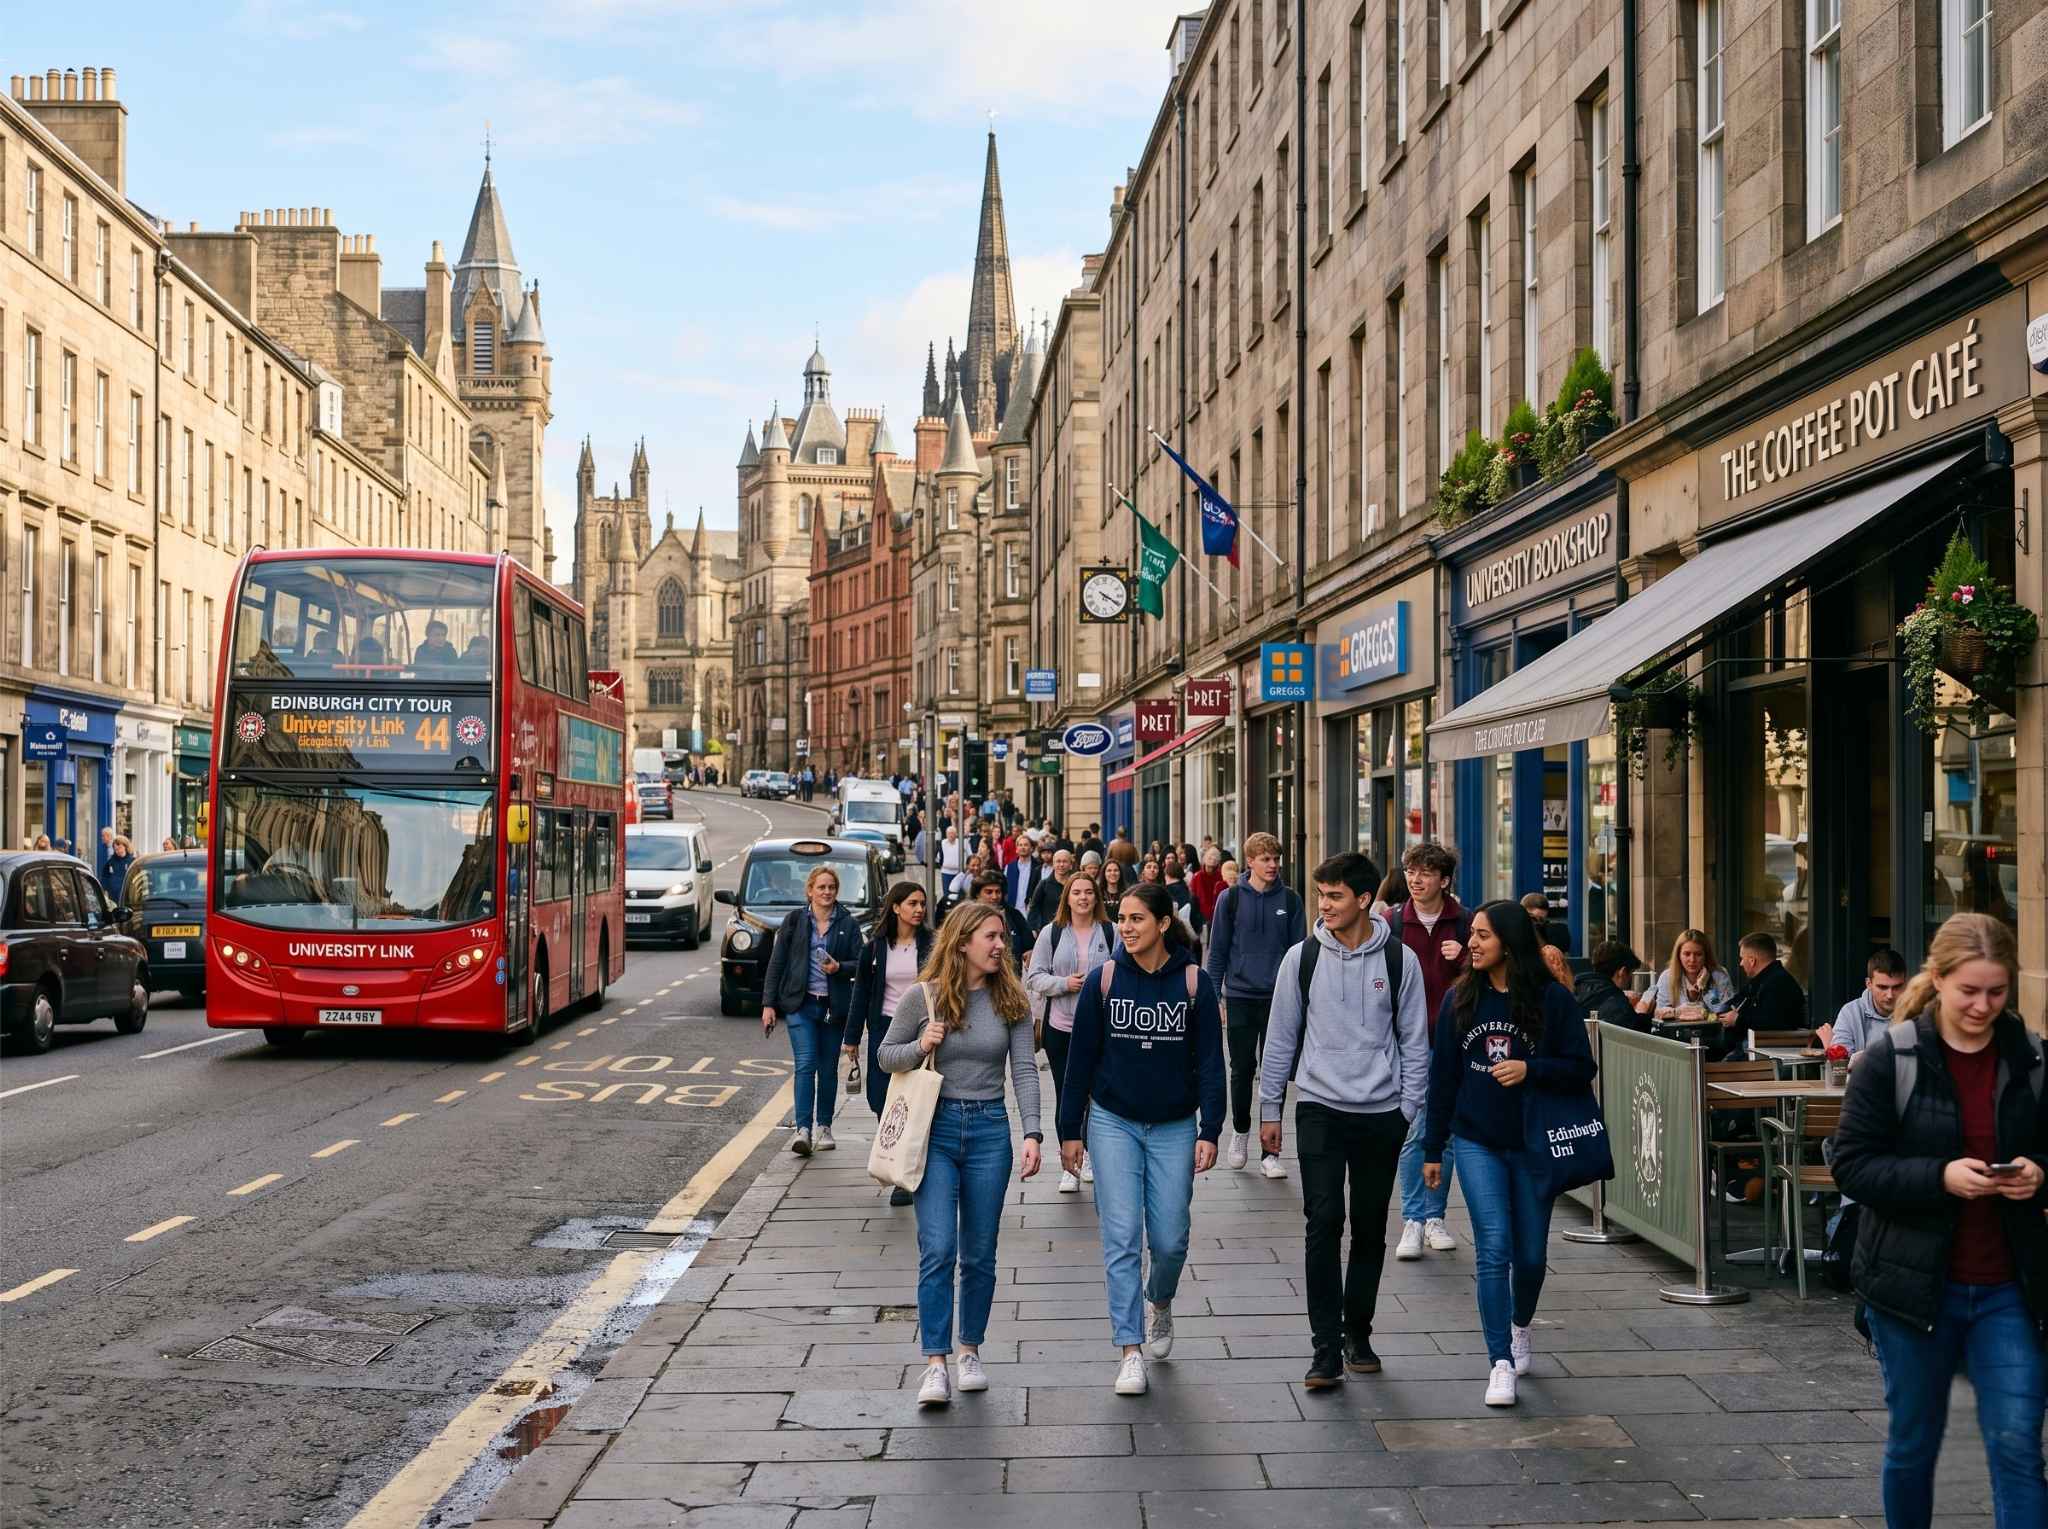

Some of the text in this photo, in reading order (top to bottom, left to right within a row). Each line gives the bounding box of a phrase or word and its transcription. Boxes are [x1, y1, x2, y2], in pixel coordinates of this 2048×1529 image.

[1720, 318, 1981, 500] THE COFFEE POT CAFÉ
[1466, 512, 1610, 608] UNIVERSITY BOOKSHOP
[1350, 616, 1396, 674] GREGGS
[1194, 689, 1222, 707] PRET
[1269, 686, 1306, 697] GREGGS
[271, 696, 452, 713] EDINBURGH CITY TOUR
[282, 714, 367, 736] University
[371, 716, 405, 735] Link
[415, 718, 449, 751] 44
[1141, 714, 1172, 732] PRET
[289, 943, 415, 958] UNIVERSITY LINK
[1110, 998, 1187, 1032] UoM
[543, 1054, 796, 1077] STOP
[519, 1080, 742, 1108] BUS
[1550, 1141, 1574, 1158] Uni
